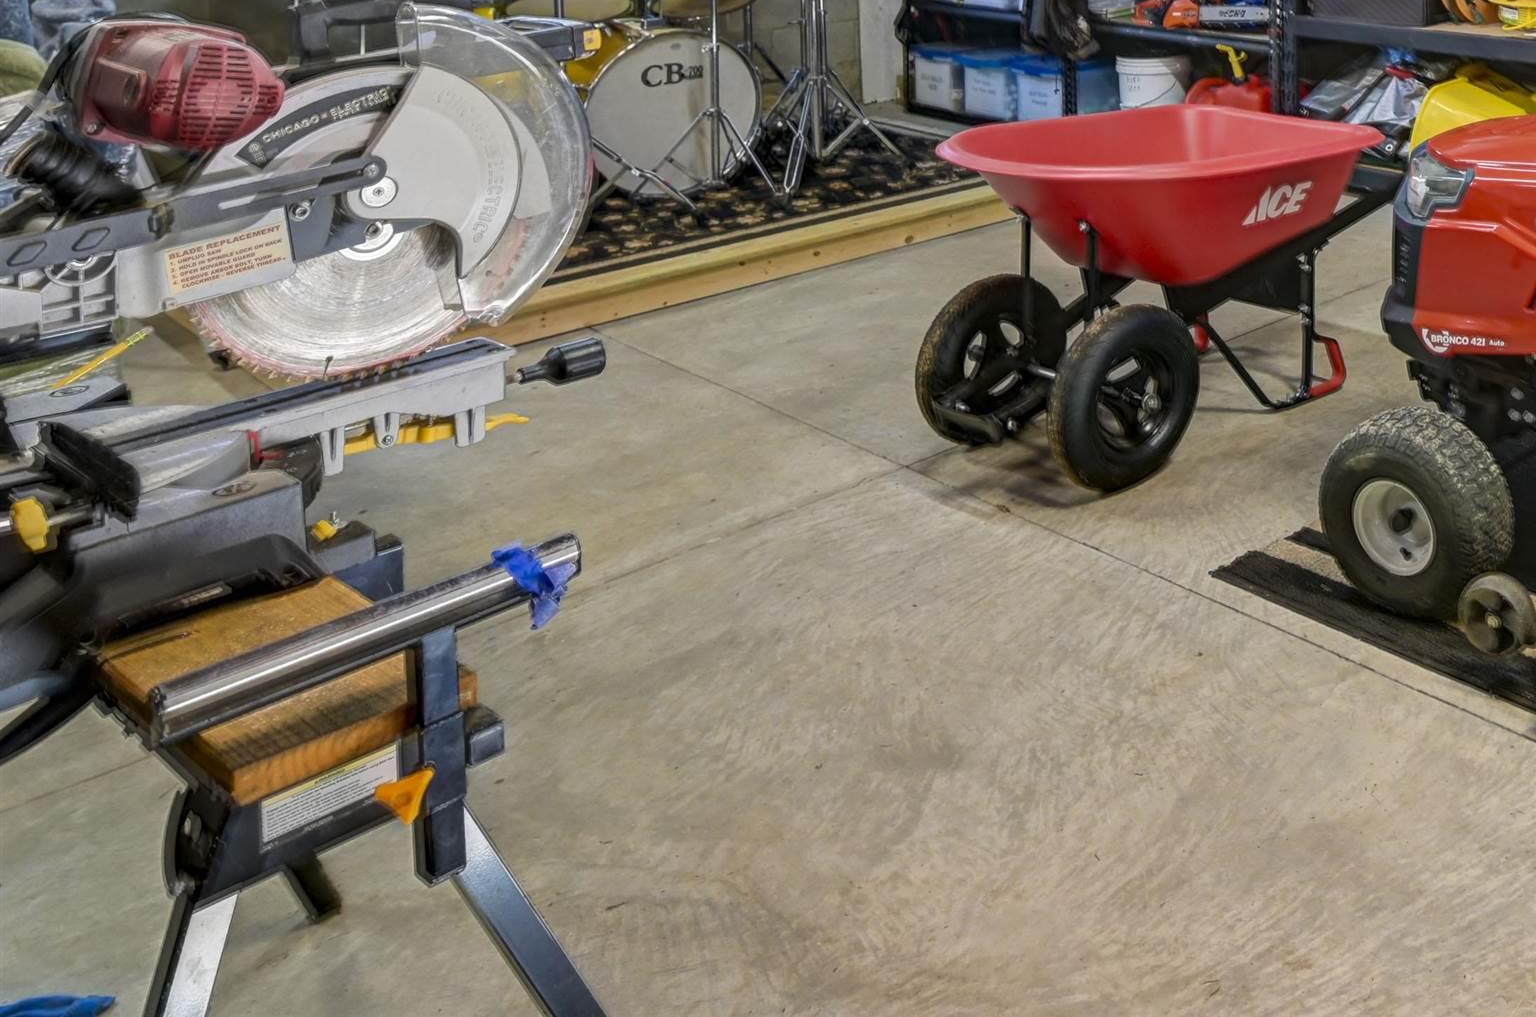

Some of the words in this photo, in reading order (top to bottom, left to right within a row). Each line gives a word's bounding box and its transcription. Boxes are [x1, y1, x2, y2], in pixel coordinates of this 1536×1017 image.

[262, 114, 320, 144] CHICAGO
[1241, 180, 1313, 226] ACE
[168, 246, 203, 260] BLADE
[206, 225, 281, 250] REPLACEMENT
[177, 253, 205, 264] UNPLUG
[1430, 334, 1470, 346] BRONCO
